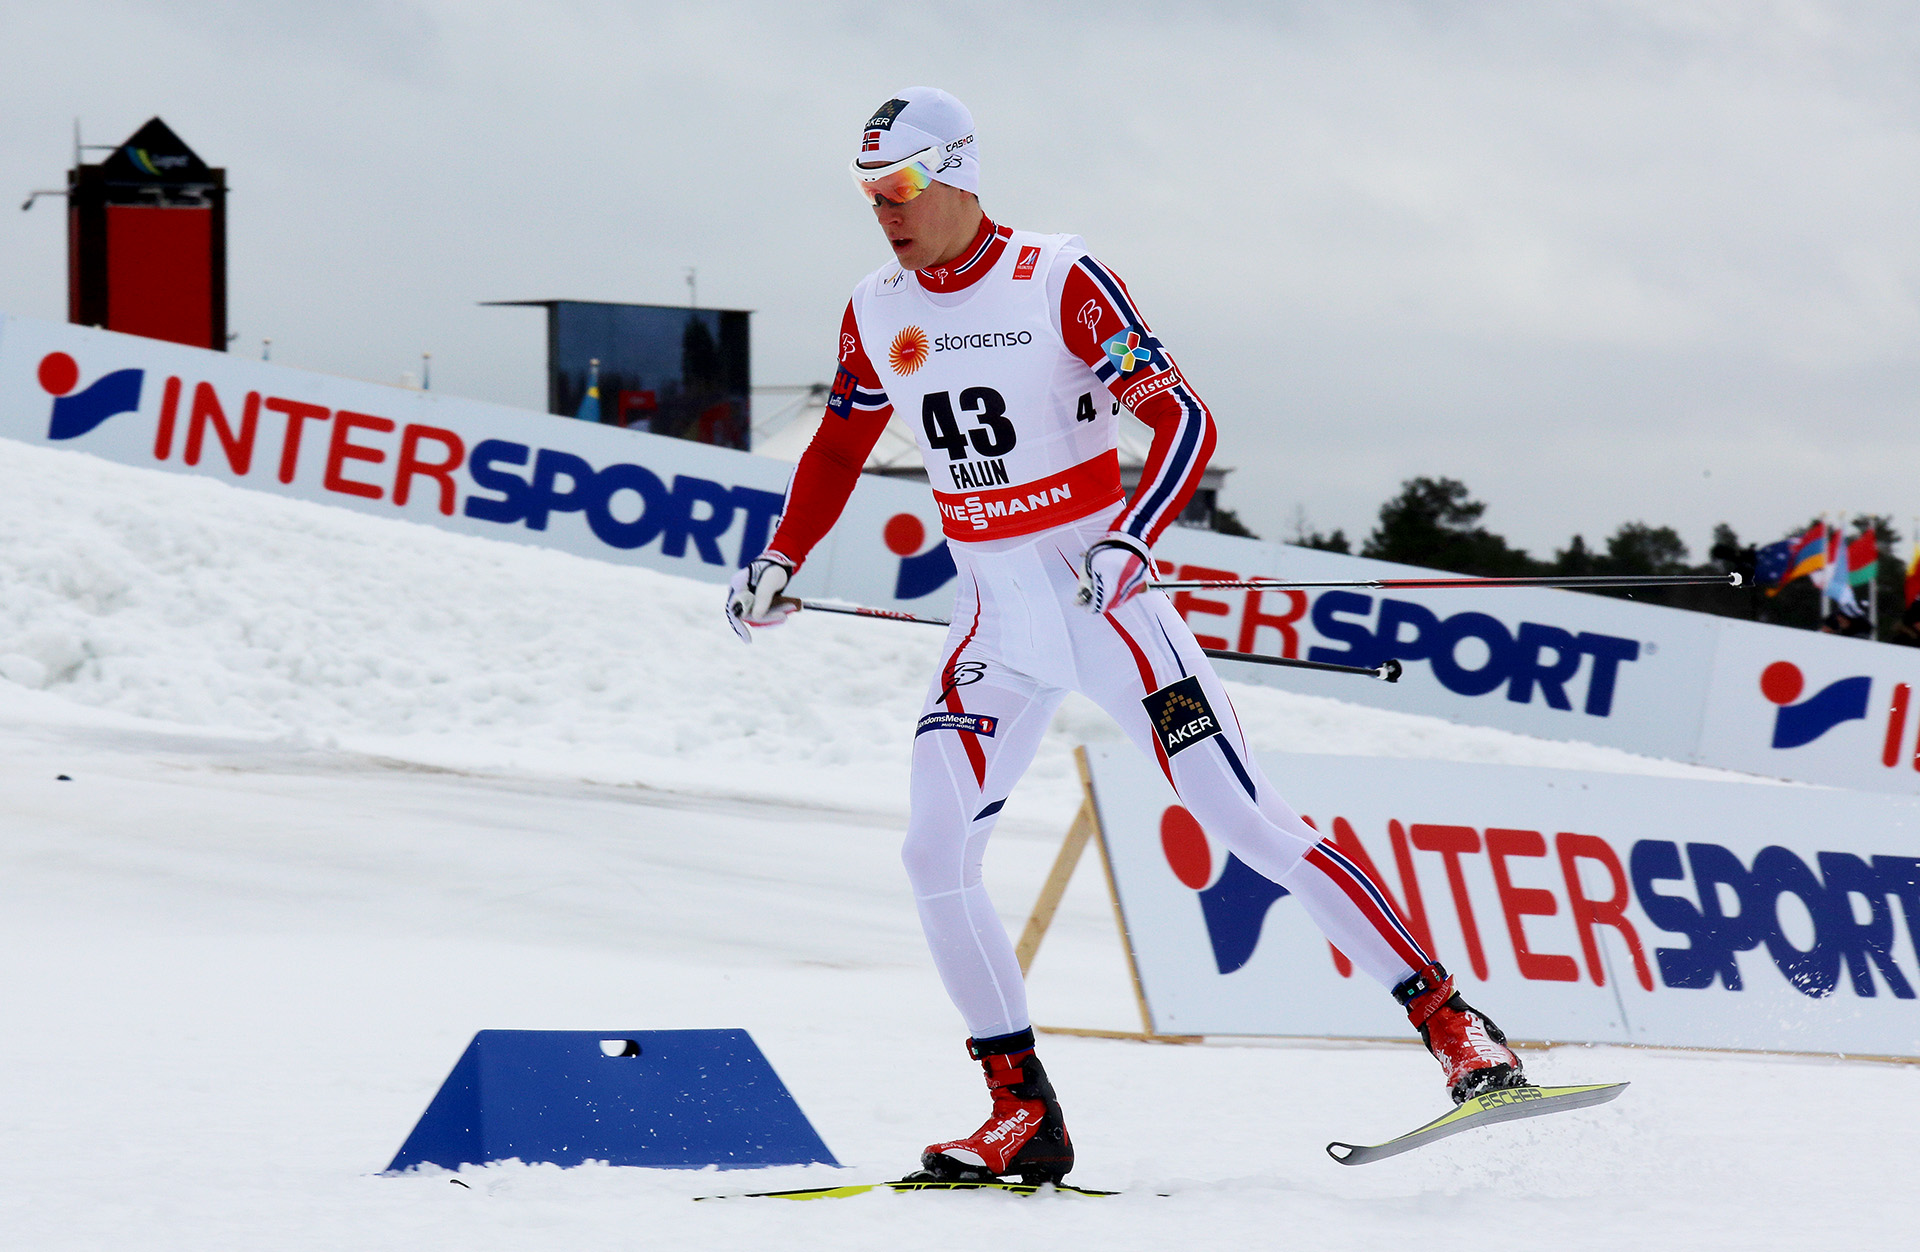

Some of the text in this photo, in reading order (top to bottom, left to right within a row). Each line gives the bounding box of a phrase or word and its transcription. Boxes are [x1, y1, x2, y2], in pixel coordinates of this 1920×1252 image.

[1125, 370, 1178, 408] Grilstad
[922, 386, 1017, 461] 43
[154, 375, 785, 570] INTERSPORT
[949, 458, 1010, 490] FALUN
[939, 483, 1072, 531] VIESSMANN
[1150, 562, 1639, 718] ERSPORT
[917, 714, 977, 727] ndomsMegler
[1168, 715, 1214, 749] AKER
[1478, 1088, 1543, 1111] FISCHER
[982, 1108, 1029, 1145] alpina
